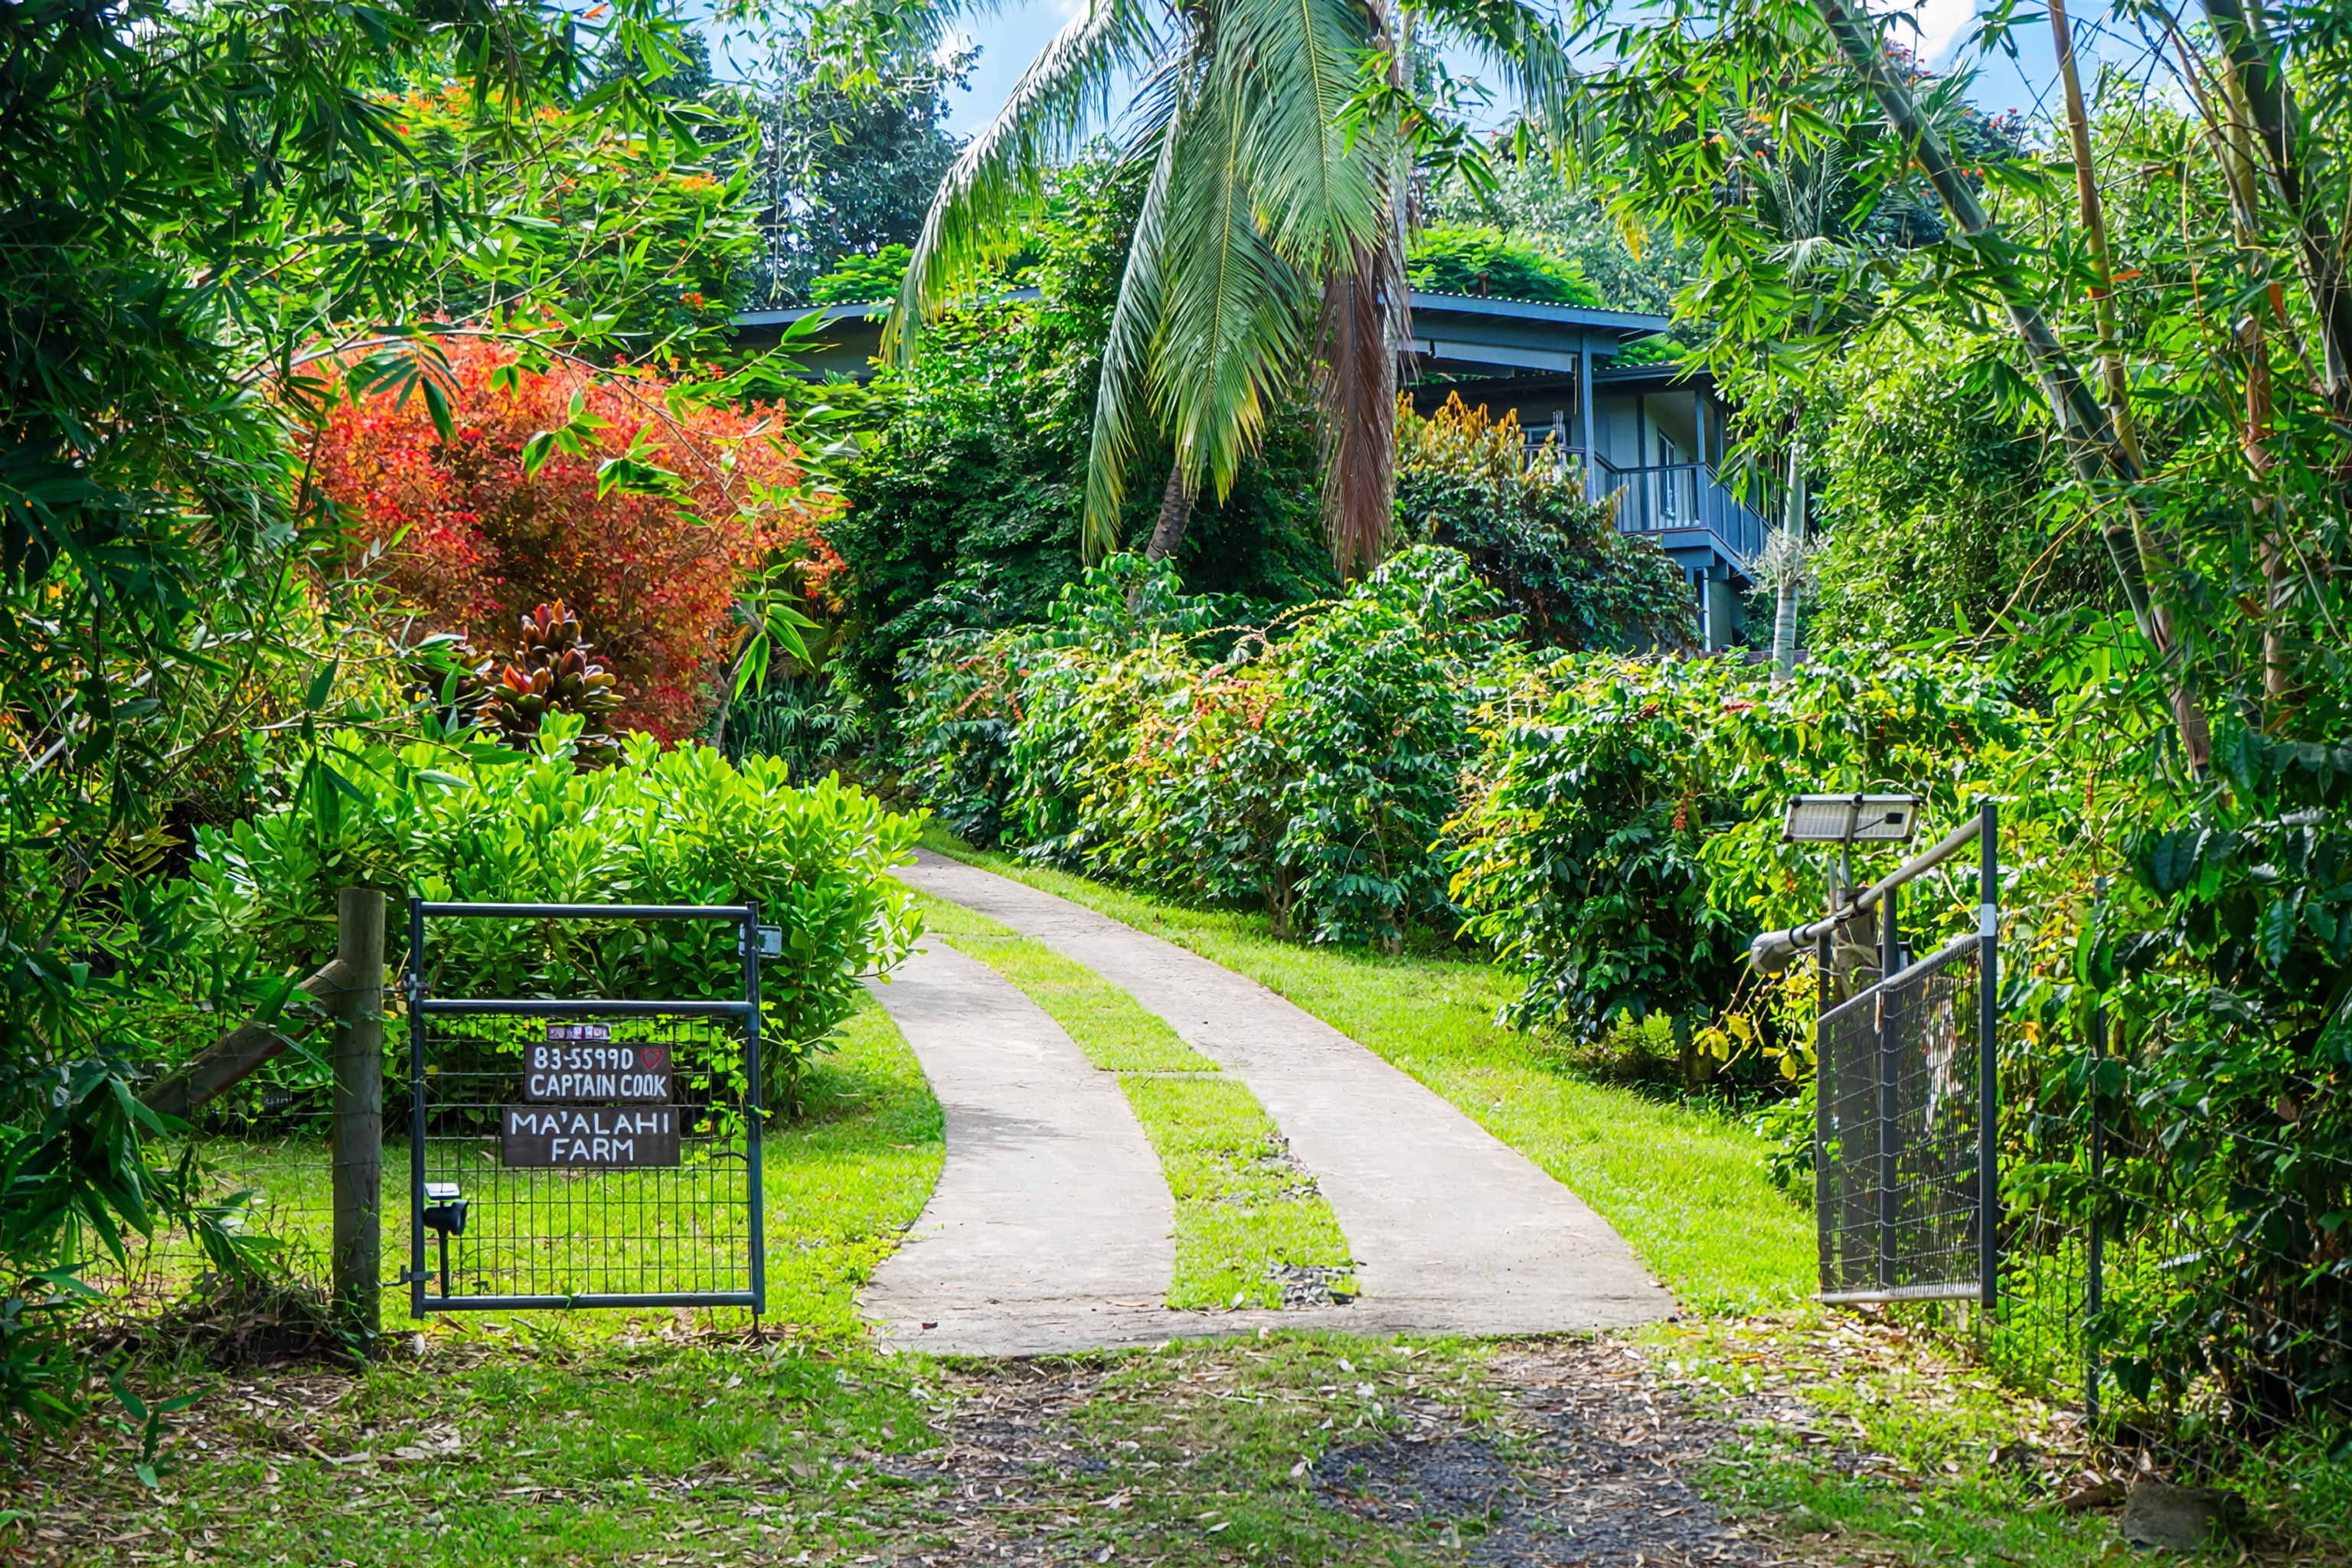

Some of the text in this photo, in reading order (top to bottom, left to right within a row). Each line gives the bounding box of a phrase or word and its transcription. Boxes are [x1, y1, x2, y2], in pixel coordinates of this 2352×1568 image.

[531, 1073, 668, 1097] CAPTAIN COOK
[511, 1111, 669, 1135] MA'ALAHI
[551, 1138, 634, 1161] FARM
